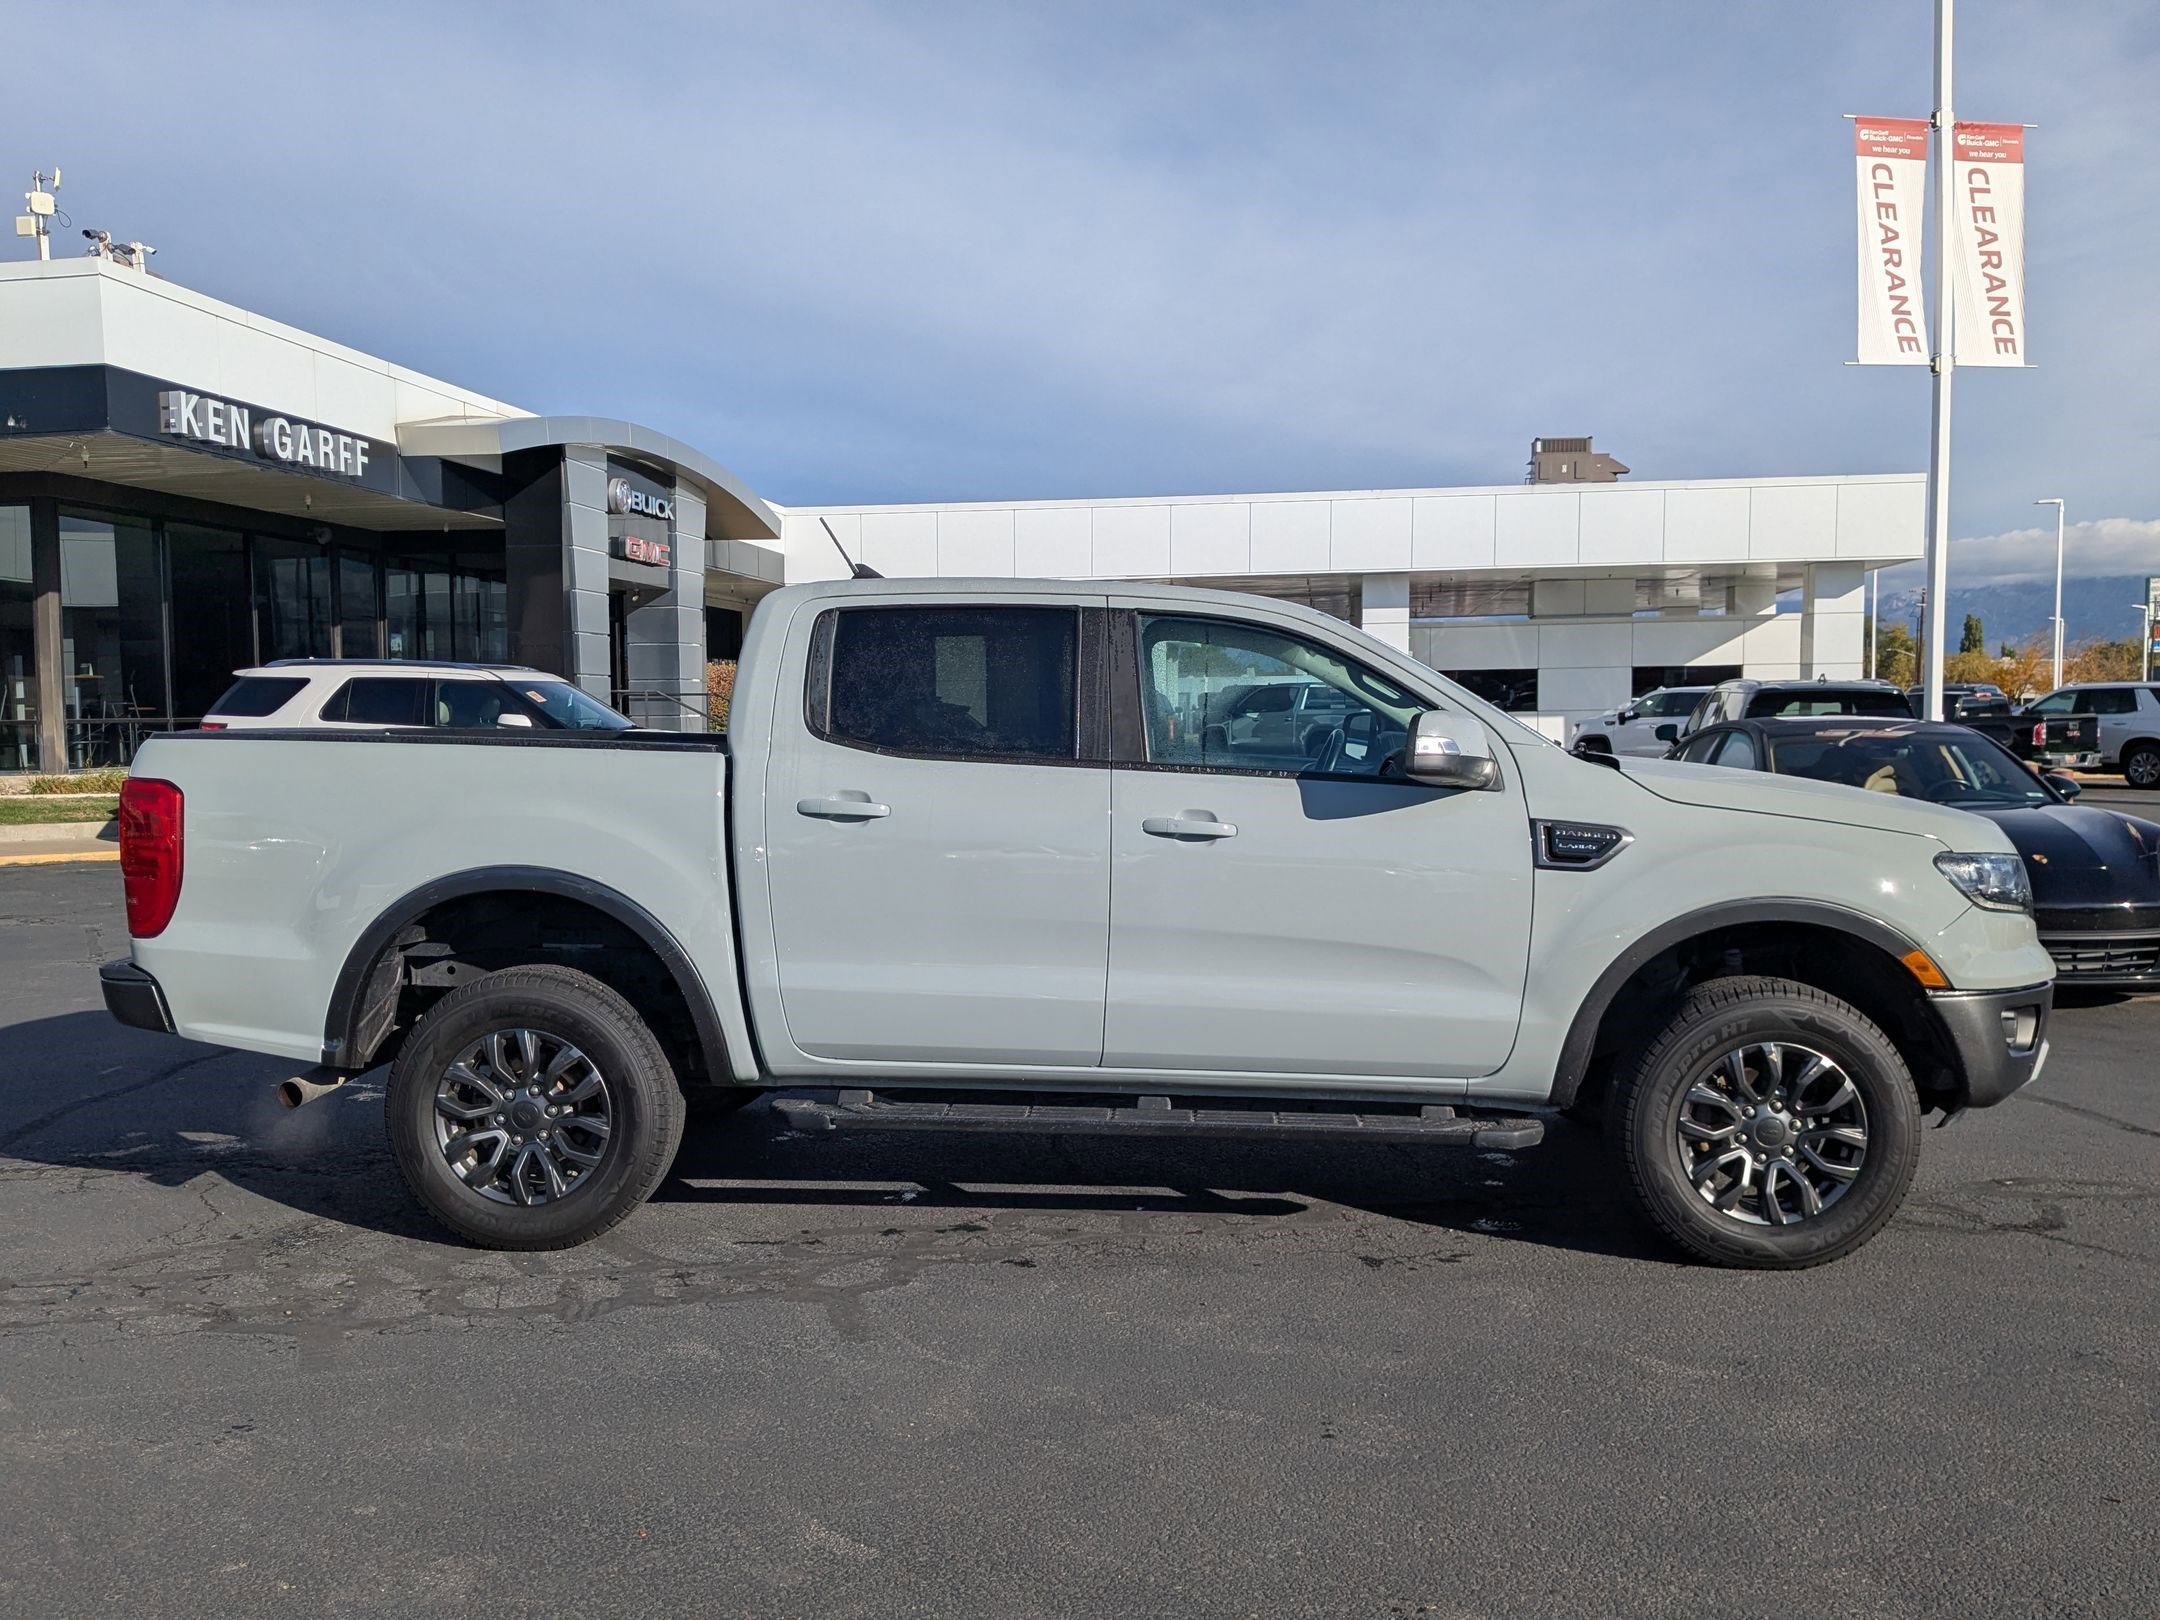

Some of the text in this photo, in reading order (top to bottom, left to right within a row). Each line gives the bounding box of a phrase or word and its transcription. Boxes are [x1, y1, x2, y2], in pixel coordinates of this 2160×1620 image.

[1882, 145, 1897, 153] hear
[1979, 150, 1993, 158] hear
[1871, 163, 1922, 353] CLEARANCE
[1967, 167, 2018, 355] CLEARANCE
[176, 390, 369, 476] KEN GARFF
[631, 490, 675, 521] BUICK
[625, 536, 671, 567] GMC
